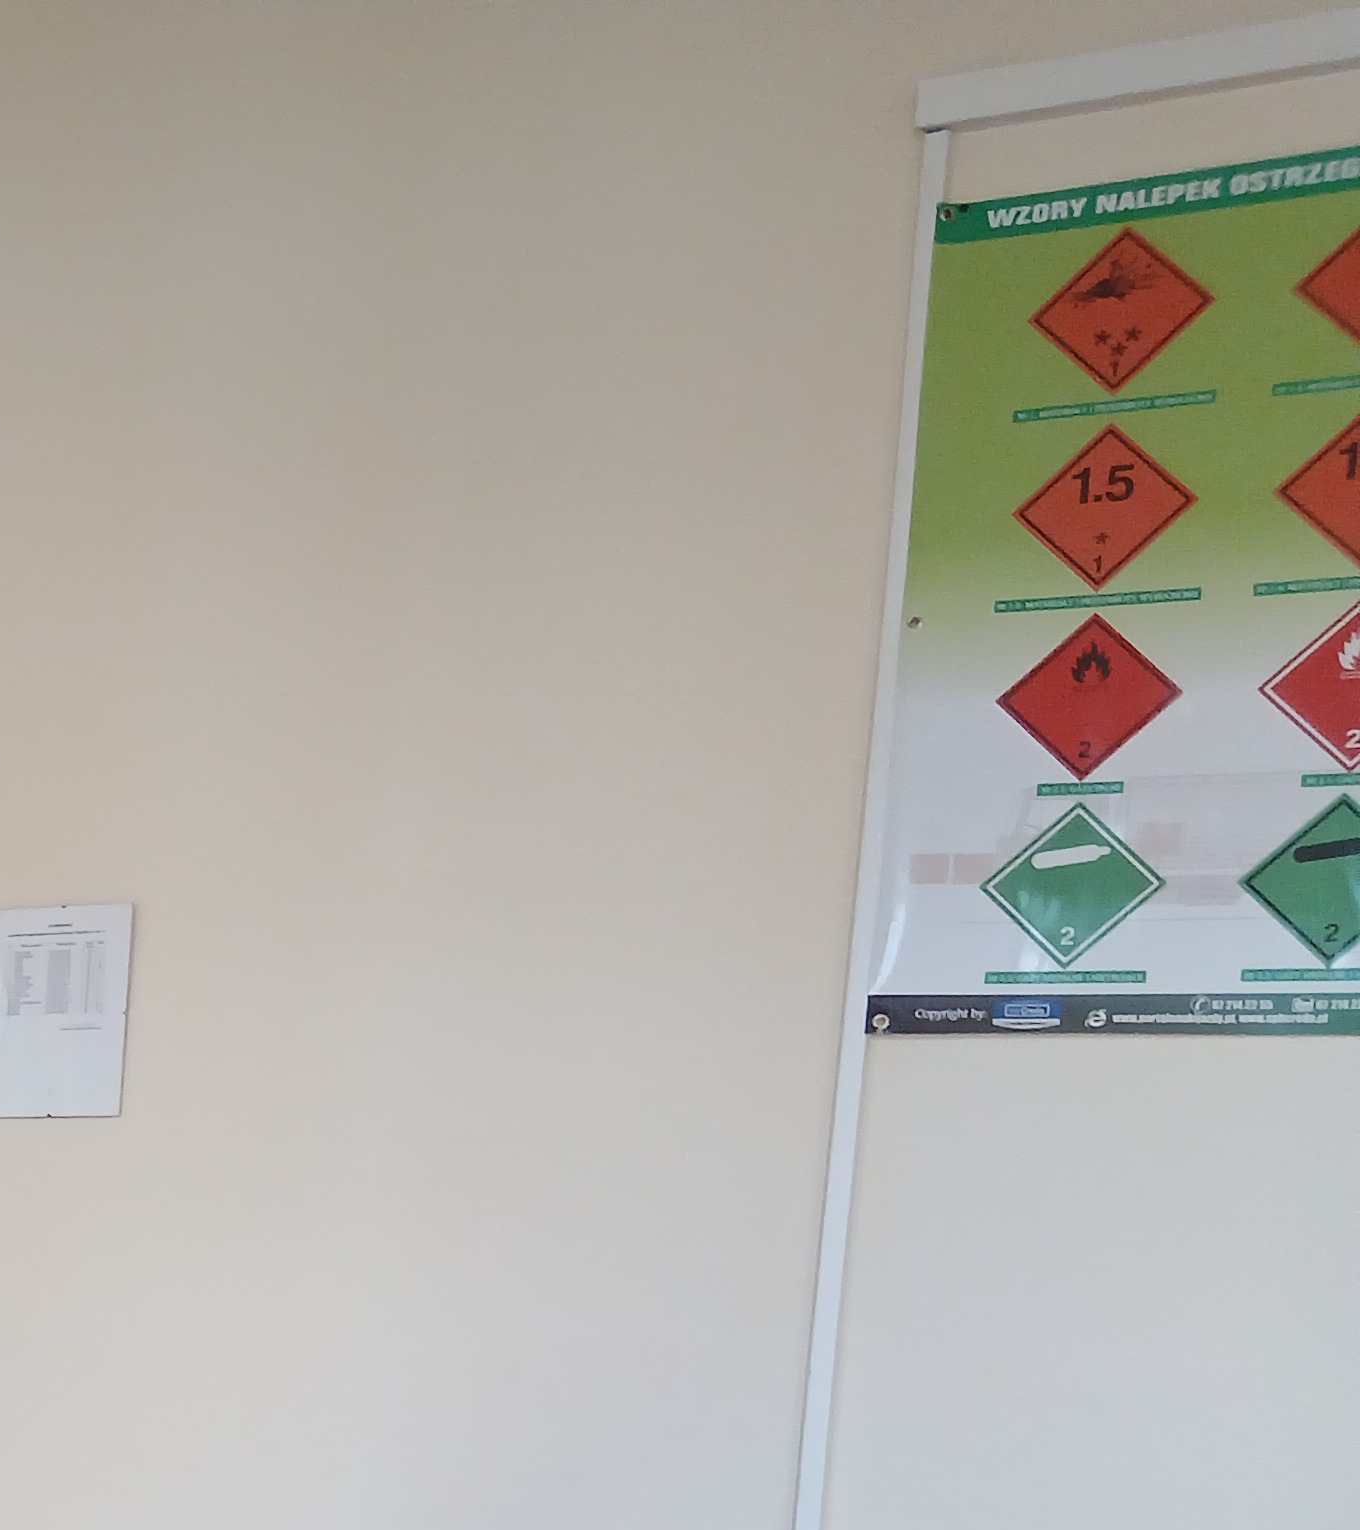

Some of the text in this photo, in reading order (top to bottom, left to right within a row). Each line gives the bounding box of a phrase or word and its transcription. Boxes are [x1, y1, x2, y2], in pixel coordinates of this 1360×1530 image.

[987, 198, 1087, 229] WZORY
[1096, 176, 1222, 215] NALEPEK
[1071, 463, 1137, 506] 1.5
[1092, 555, 1104, 574] 1
[1077, 741, 1092, 759] 2
[1059, 926, 1076, 947] 2
[1324, 923, 1339, 943] 2
